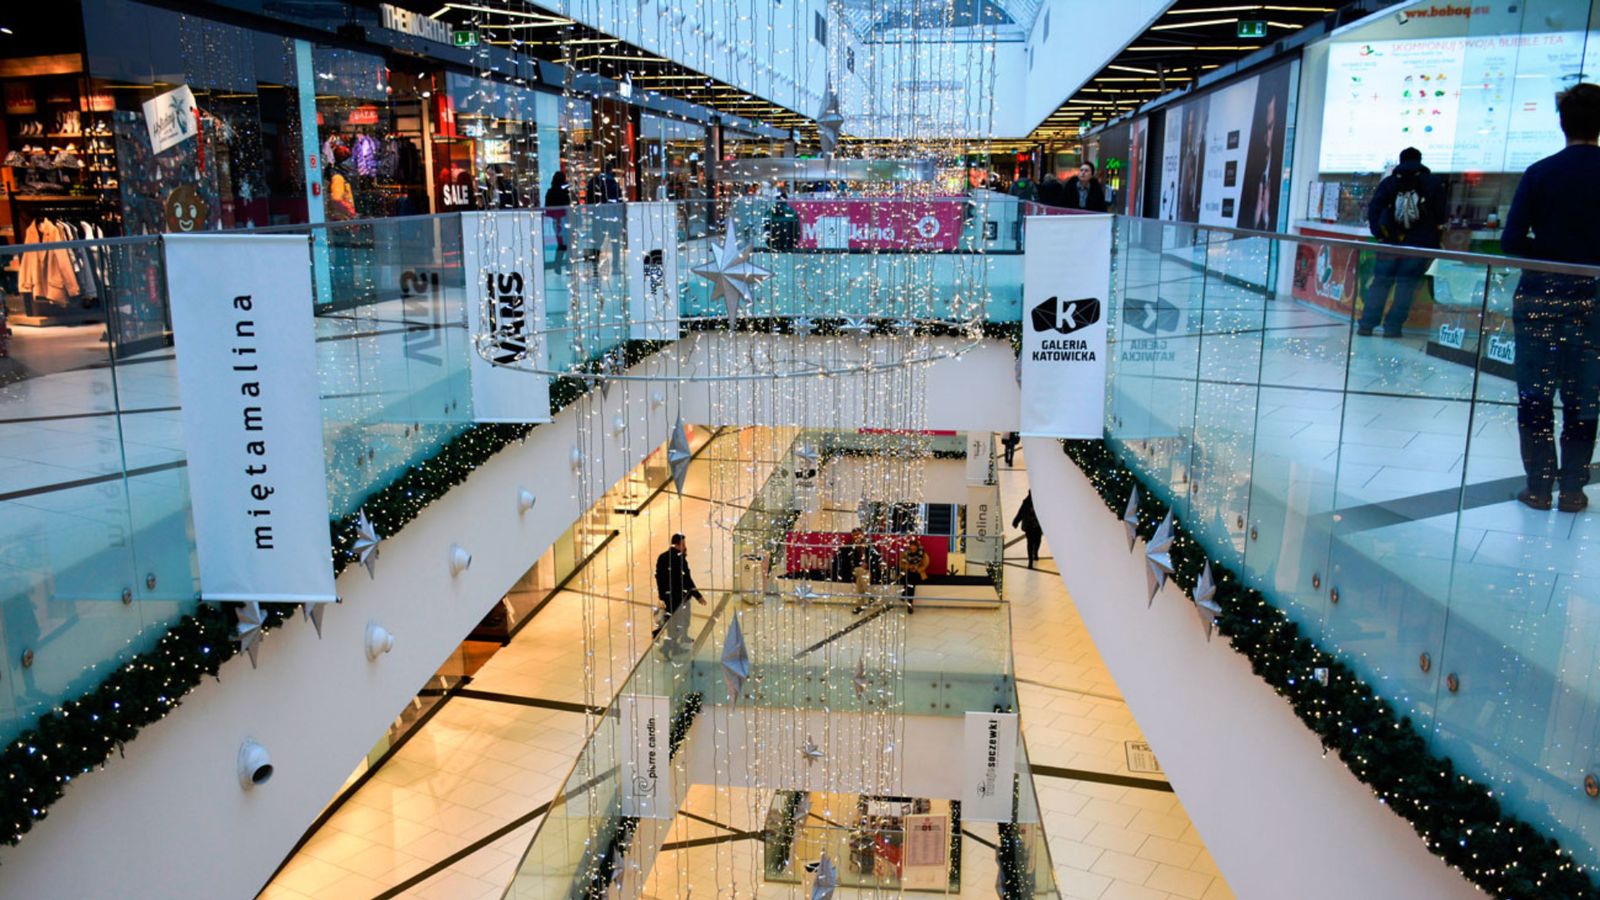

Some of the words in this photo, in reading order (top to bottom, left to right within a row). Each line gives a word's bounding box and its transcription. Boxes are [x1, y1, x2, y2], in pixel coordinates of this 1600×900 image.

[379, 3, 411, 34] THE
[443, 184, 469, 207] SALE
[487, 271, 529, 367] VANS
[1032, 351, 1096, 362] KATOWICKA
[1042, 340, 1087, 350] GALERIA
[233, 294, 274, 549] miętamalina
[975, 503, 988, 543] felina
[646, 718, 657, 748] cardin
[647, 750, 659, 779] pierre
